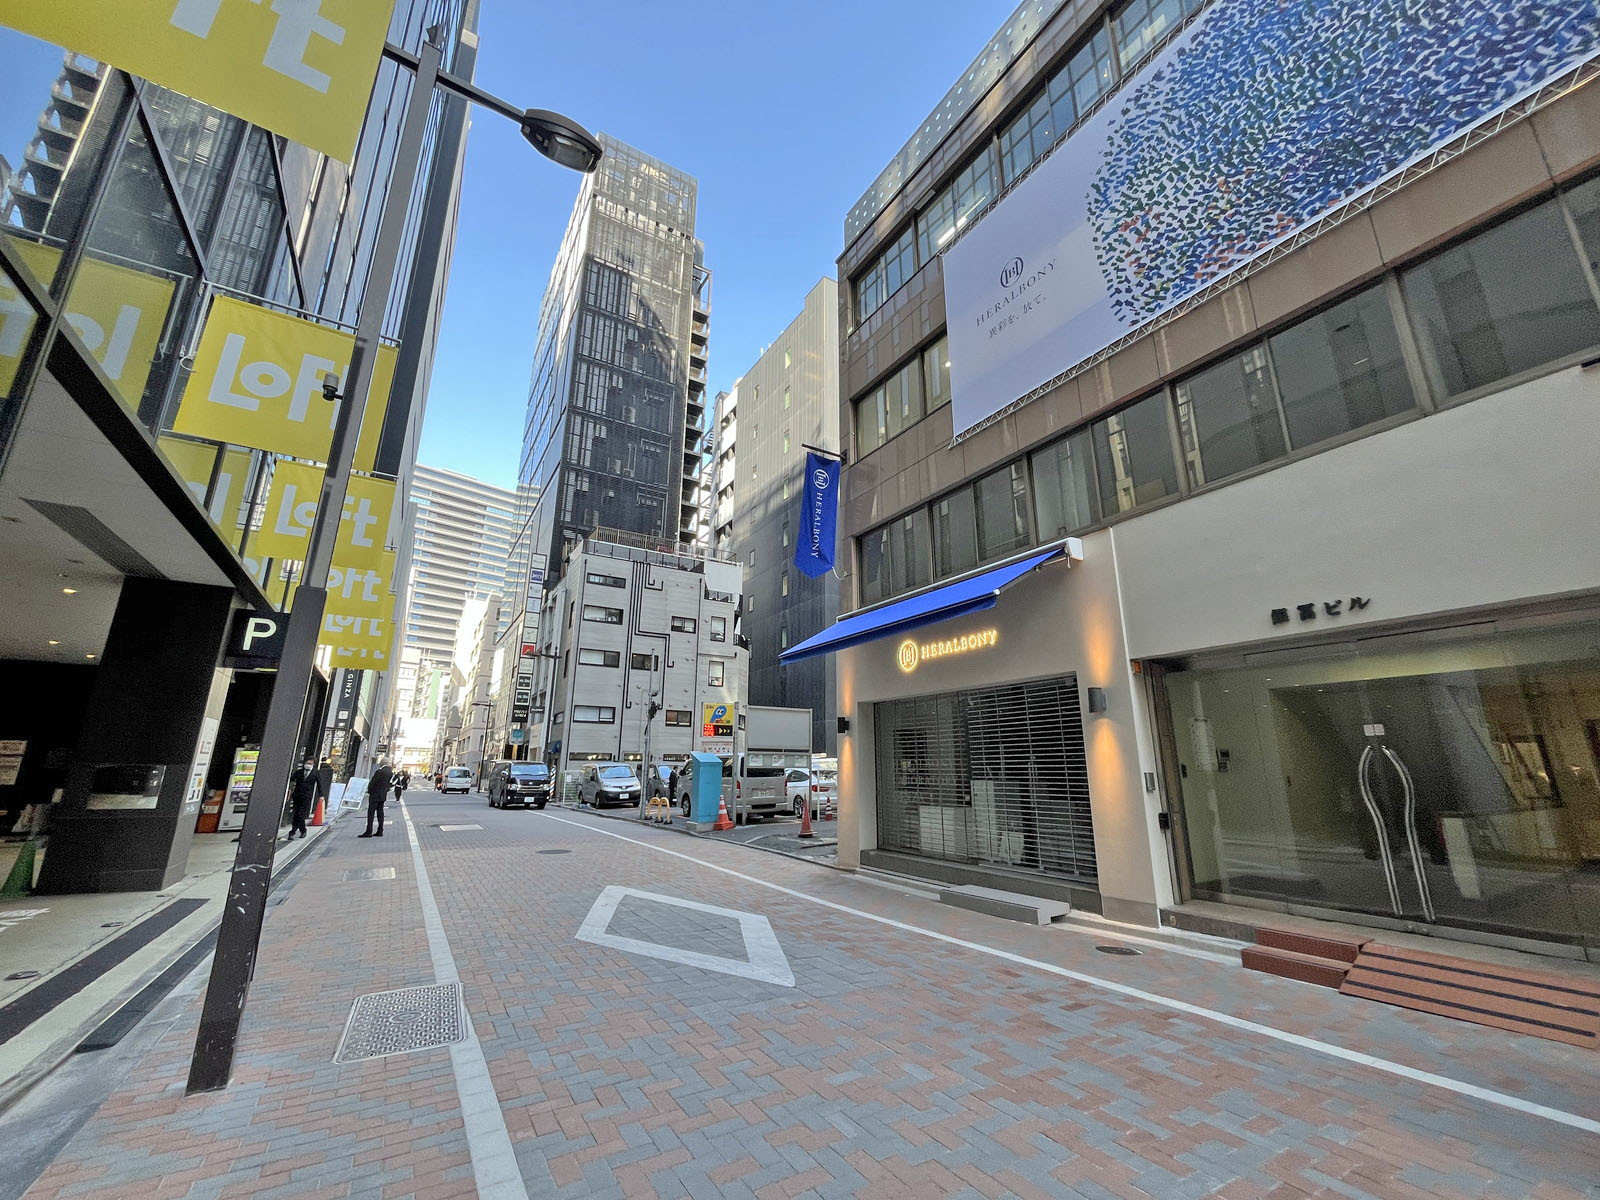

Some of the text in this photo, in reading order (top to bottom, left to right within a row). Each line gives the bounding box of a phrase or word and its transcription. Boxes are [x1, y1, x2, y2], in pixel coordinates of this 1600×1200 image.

[976, 258, 1056, 327] HERALBONY
[208, 332, 350, 431] LoF
[811, 492, 823, 558] HERALBONY
[243, 617, 277, 650] P
[920, 629, 998, 660] HERALBONY
[343, 673, 355, 699] GINZA
